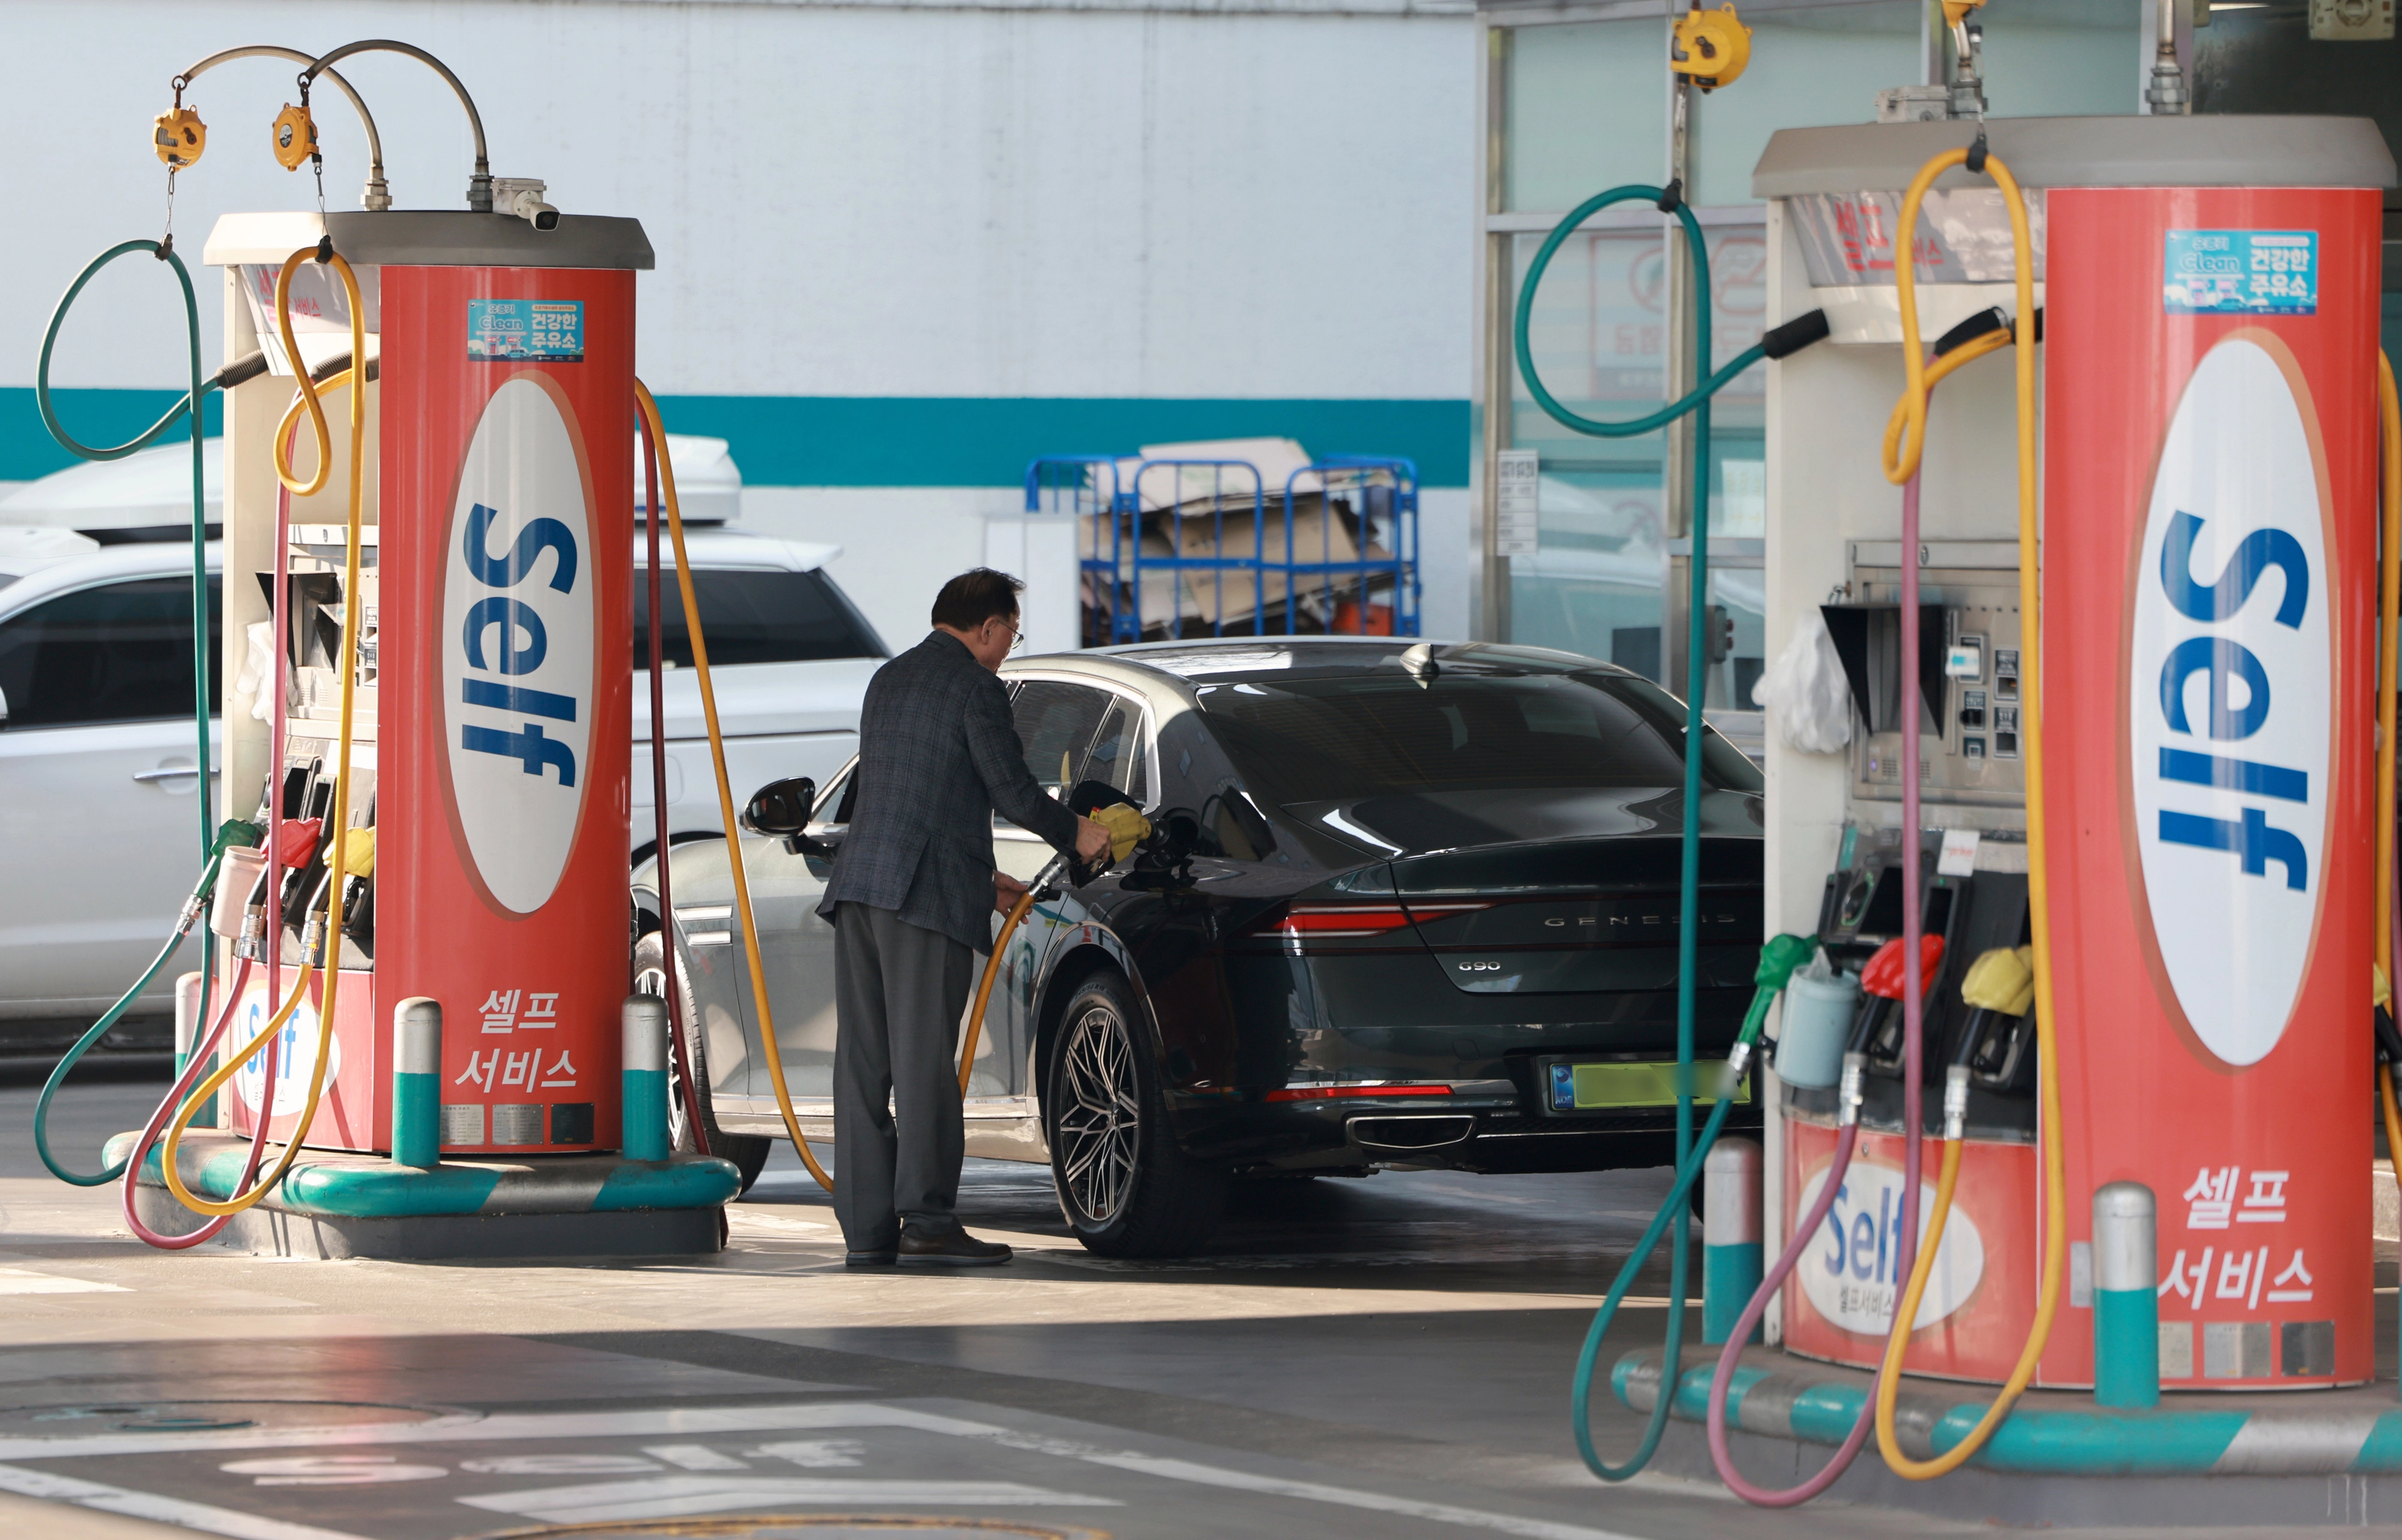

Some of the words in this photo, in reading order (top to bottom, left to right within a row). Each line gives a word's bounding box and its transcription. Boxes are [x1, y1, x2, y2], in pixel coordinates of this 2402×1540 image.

[1835, 202, 1896, 272] 셀프
[1913, 236, 1944, 268] 비스
[2180, 252, 2240, 273] Clean
[2251, 247, 2310, 271] 건강한
[2249, 273, 2308, 297] 주유소
[479, 315, 523, 331] Clean
[531, 313, 577, 330] 건강한
[531, 331, 576, 349] 주유소
[462, 503, 578, 788] Self
[2158, 509, 2310, 893] Self
[1459, 961, 1501, 971] G90
[478, 989, 559, 1034] 셀프
[454, 1048, 576, 1093] 서비스
[1554, 1095, 1573, 1105] KOR
[2182, 1165, 2290, 1229] 셀프
[2158, 1245, 2313, 1310] 서비스
